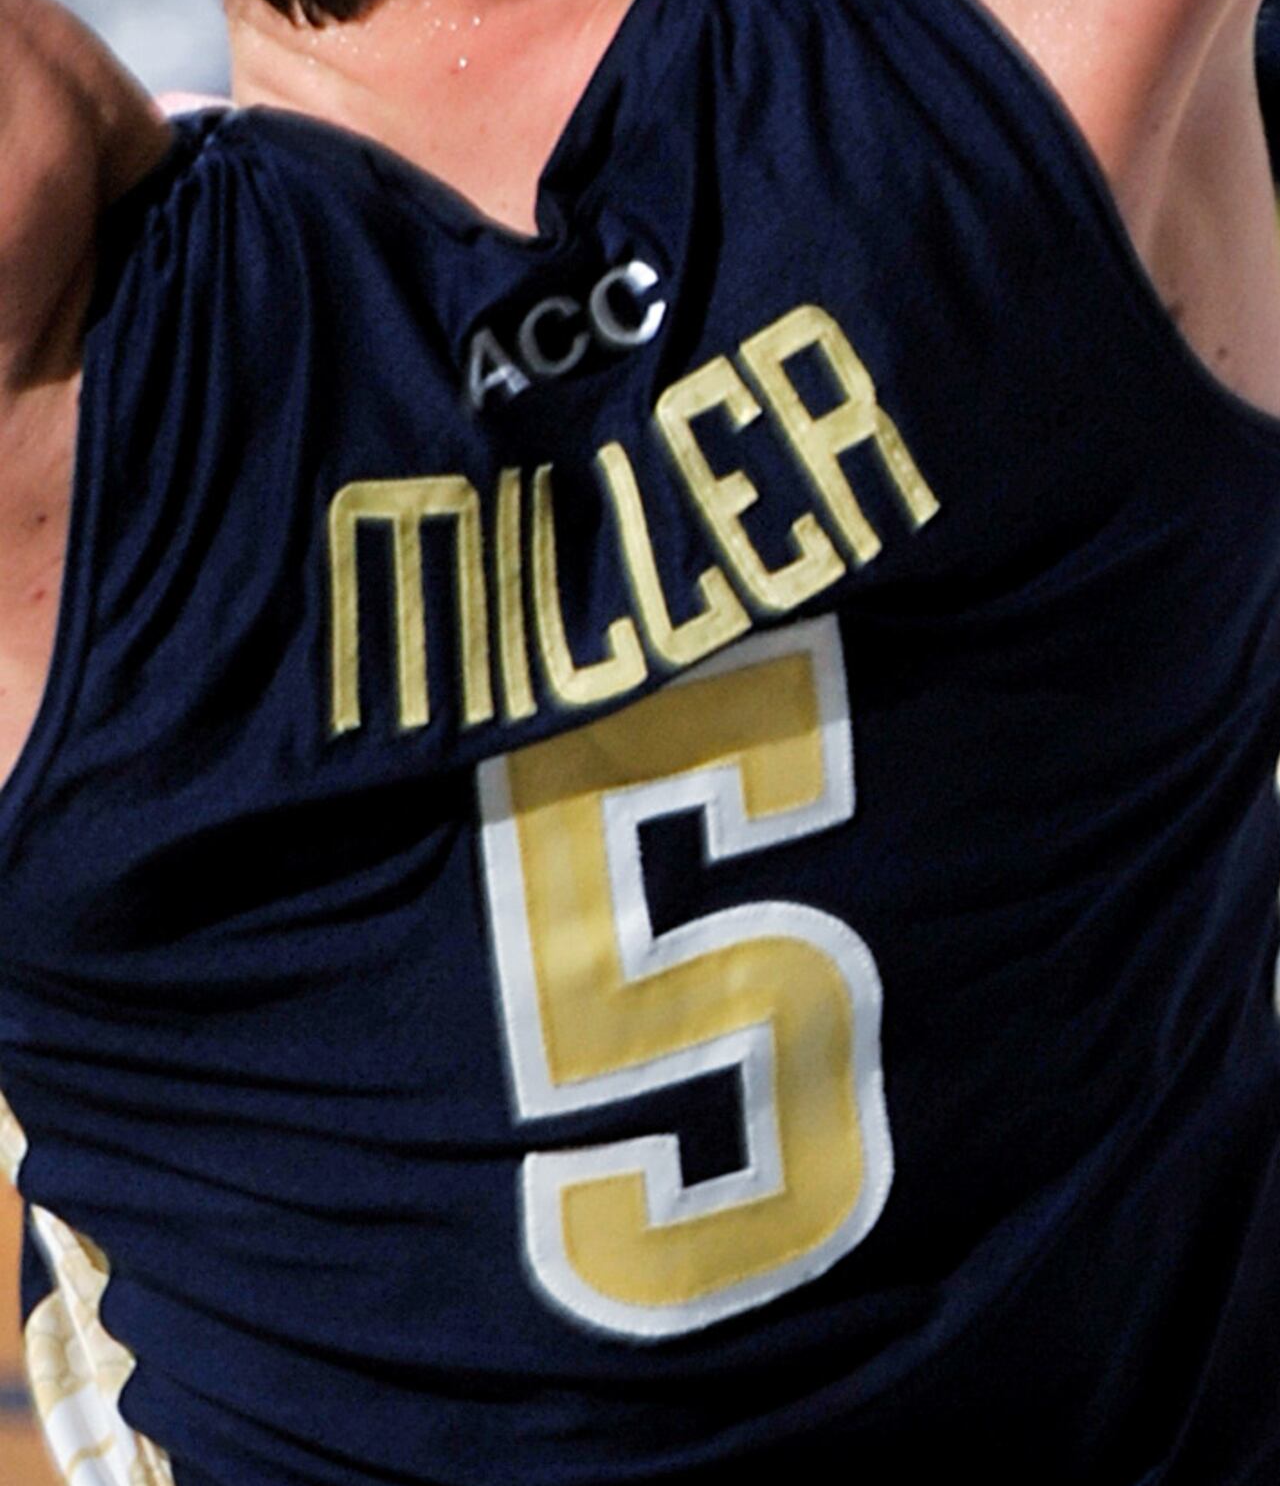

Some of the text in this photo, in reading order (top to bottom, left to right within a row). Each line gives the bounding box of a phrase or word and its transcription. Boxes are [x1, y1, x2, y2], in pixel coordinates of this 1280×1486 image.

[328, 304, 941, 735] MILLER
[467, 259, 668, 410] ACC
[475, 612, 896, 1344] 5
